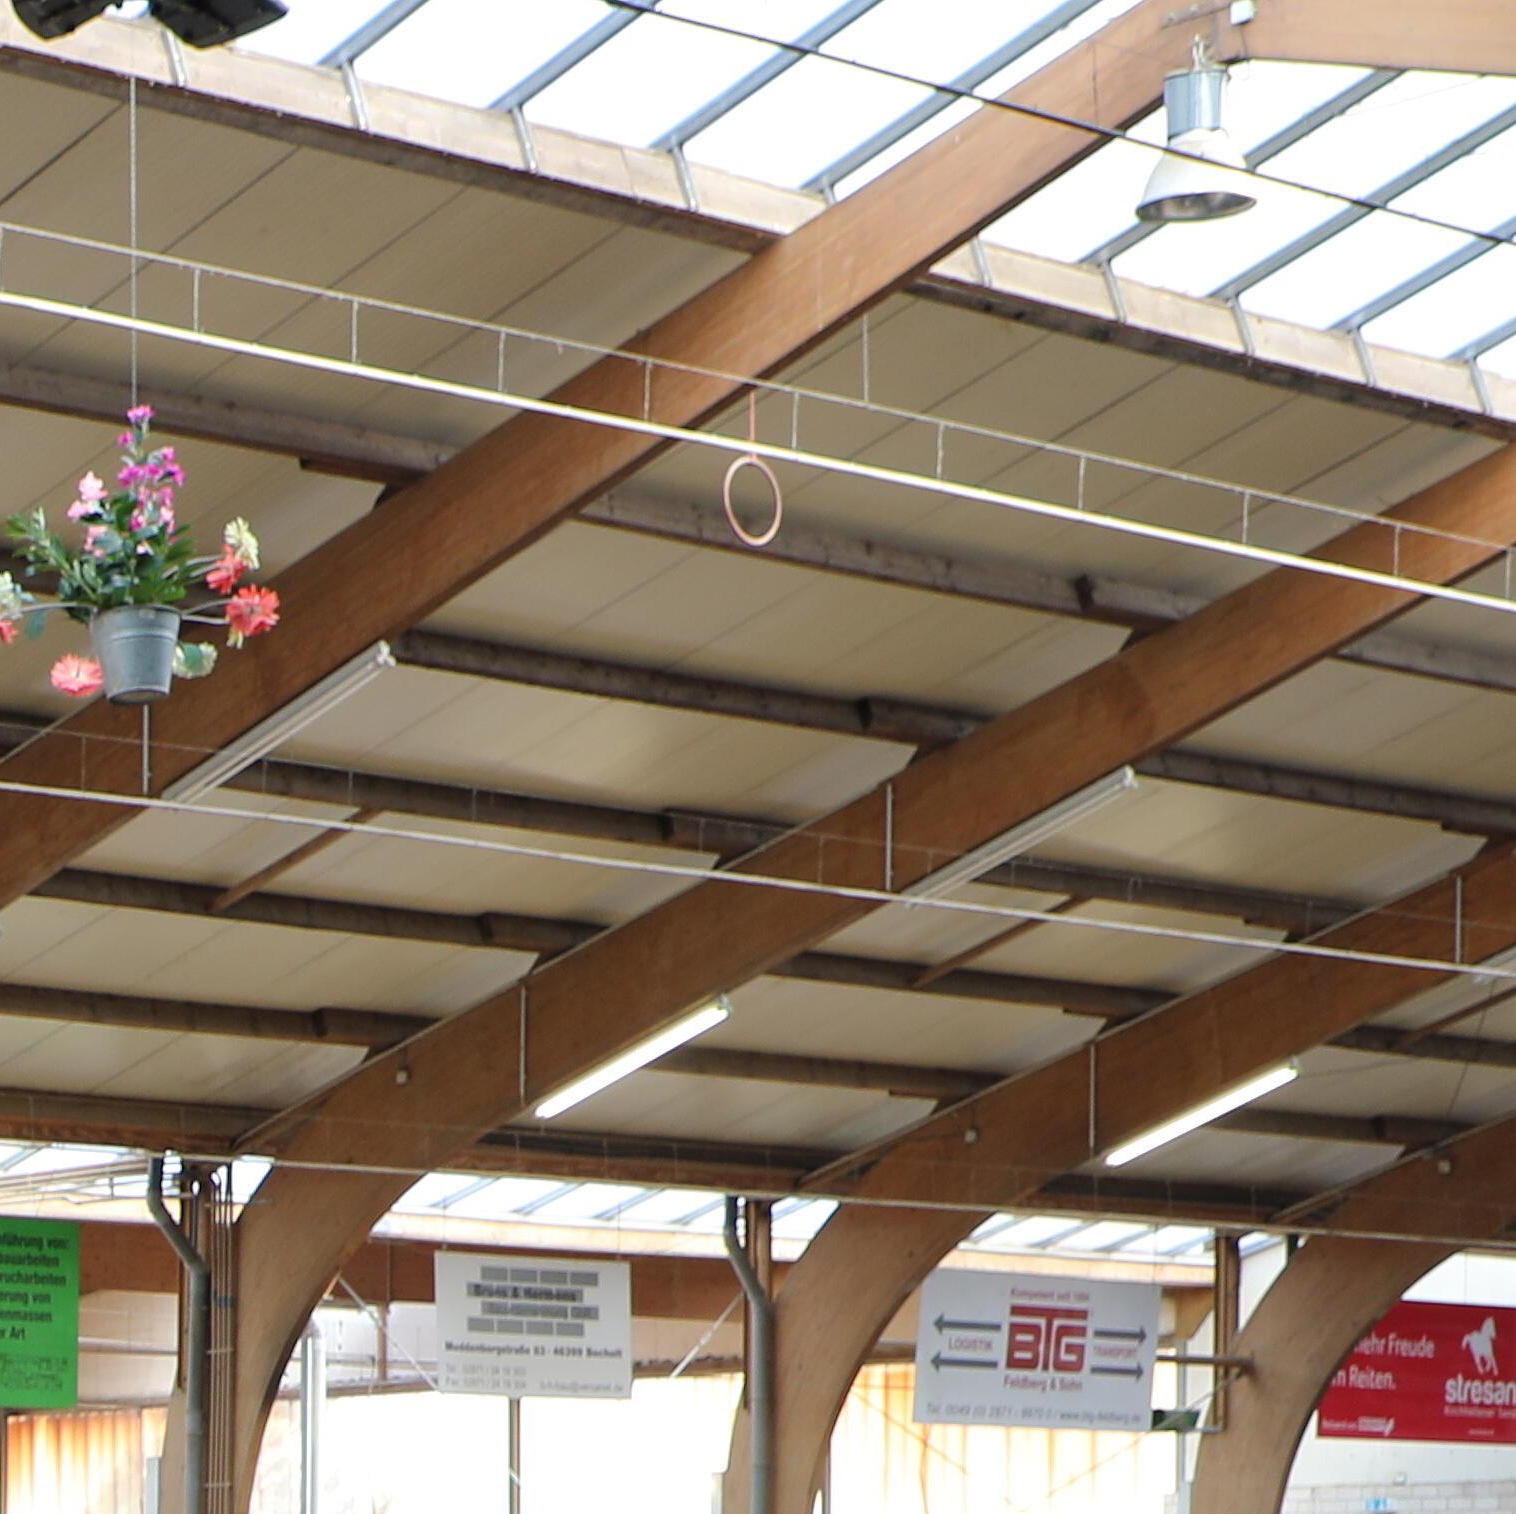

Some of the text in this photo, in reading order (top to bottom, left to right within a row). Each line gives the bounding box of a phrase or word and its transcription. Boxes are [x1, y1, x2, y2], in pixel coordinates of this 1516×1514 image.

[10, 1325, 25, 1340] Art
[948, 1336, 993, 1351] LOGISTIK
[1388, 1332, 1436, 1359] Freude
[1349, 1364, 1397, 1390] Reiten.
